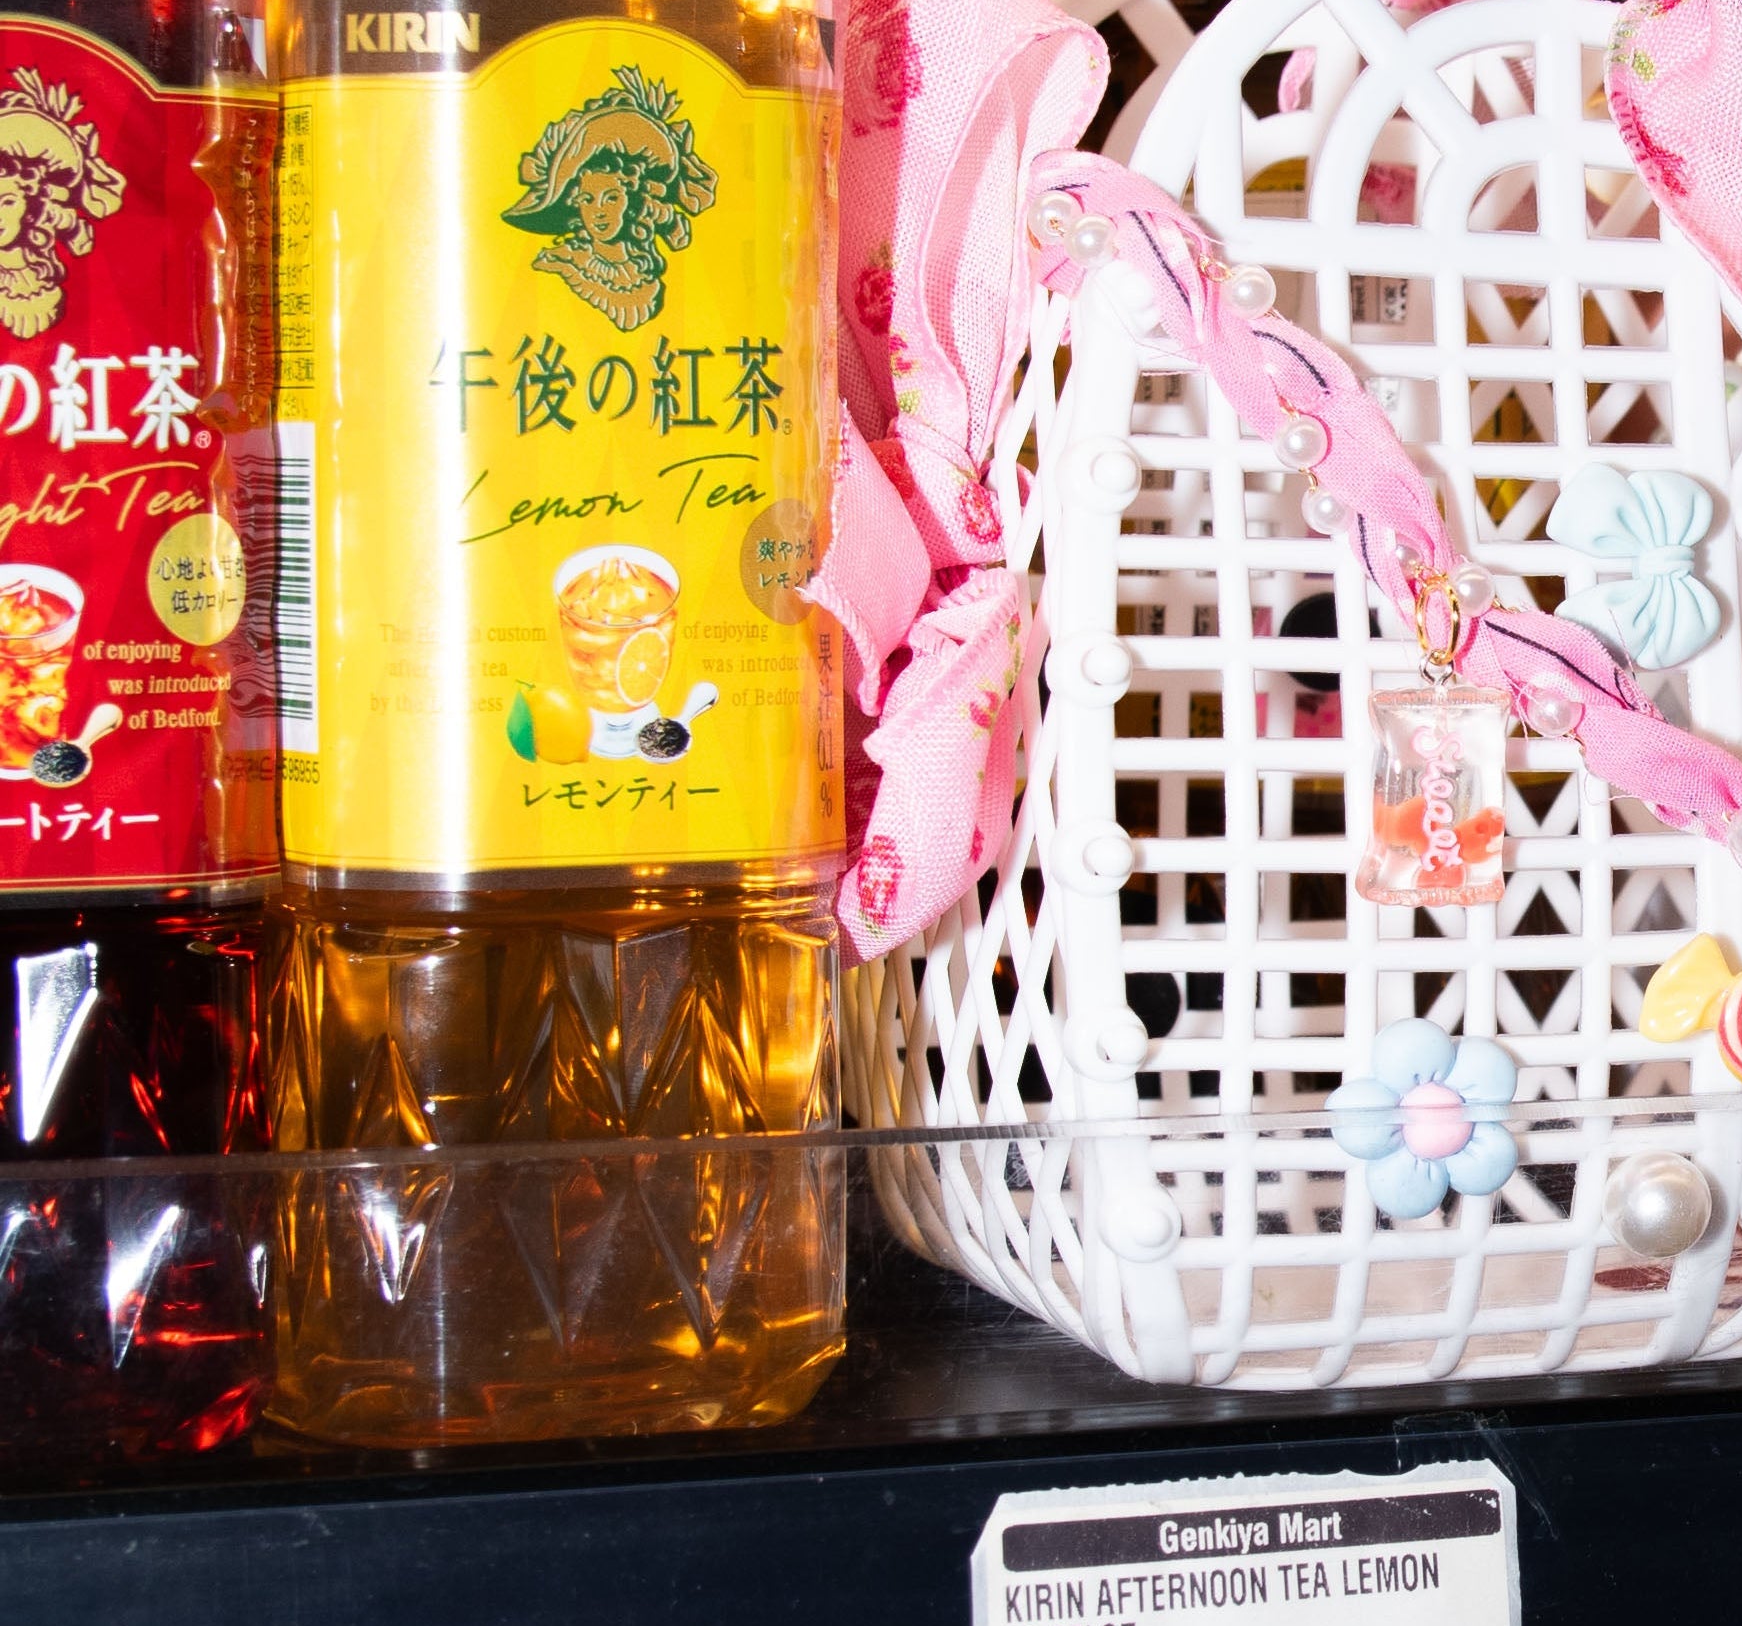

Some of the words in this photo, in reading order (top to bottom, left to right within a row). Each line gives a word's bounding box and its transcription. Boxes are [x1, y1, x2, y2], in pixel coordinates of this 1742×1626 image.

[347, 11, 481, 54] KIRIN
[429, 331, 785, 440] 午後の紅茶
[459, 466, 643, 546] Lemon
[658, 451, 767, 513] Tea
[83, 638, 103, 661] of
[106, 640, 182, 665] enjoying
[703, 621, 768, 645] enjoying
[108, 677, 143, 695] was
[148, 670, 231, 695] introduced
[128, 707, 149, 730] of
[521, 775, 721, 812] レモンティー
[1159, 1516, 1270, 1556] Genkiya
[1279, 1510, 1343, 1544] Mart
[1005, 1580, 1084, 1624] KIRIN
[1096, 1565, 1269, 1618] AFTERNOON
[1278, 1561, 1331, 1600] TEA
[1343, 1551, 1441, 1597] LEMON
